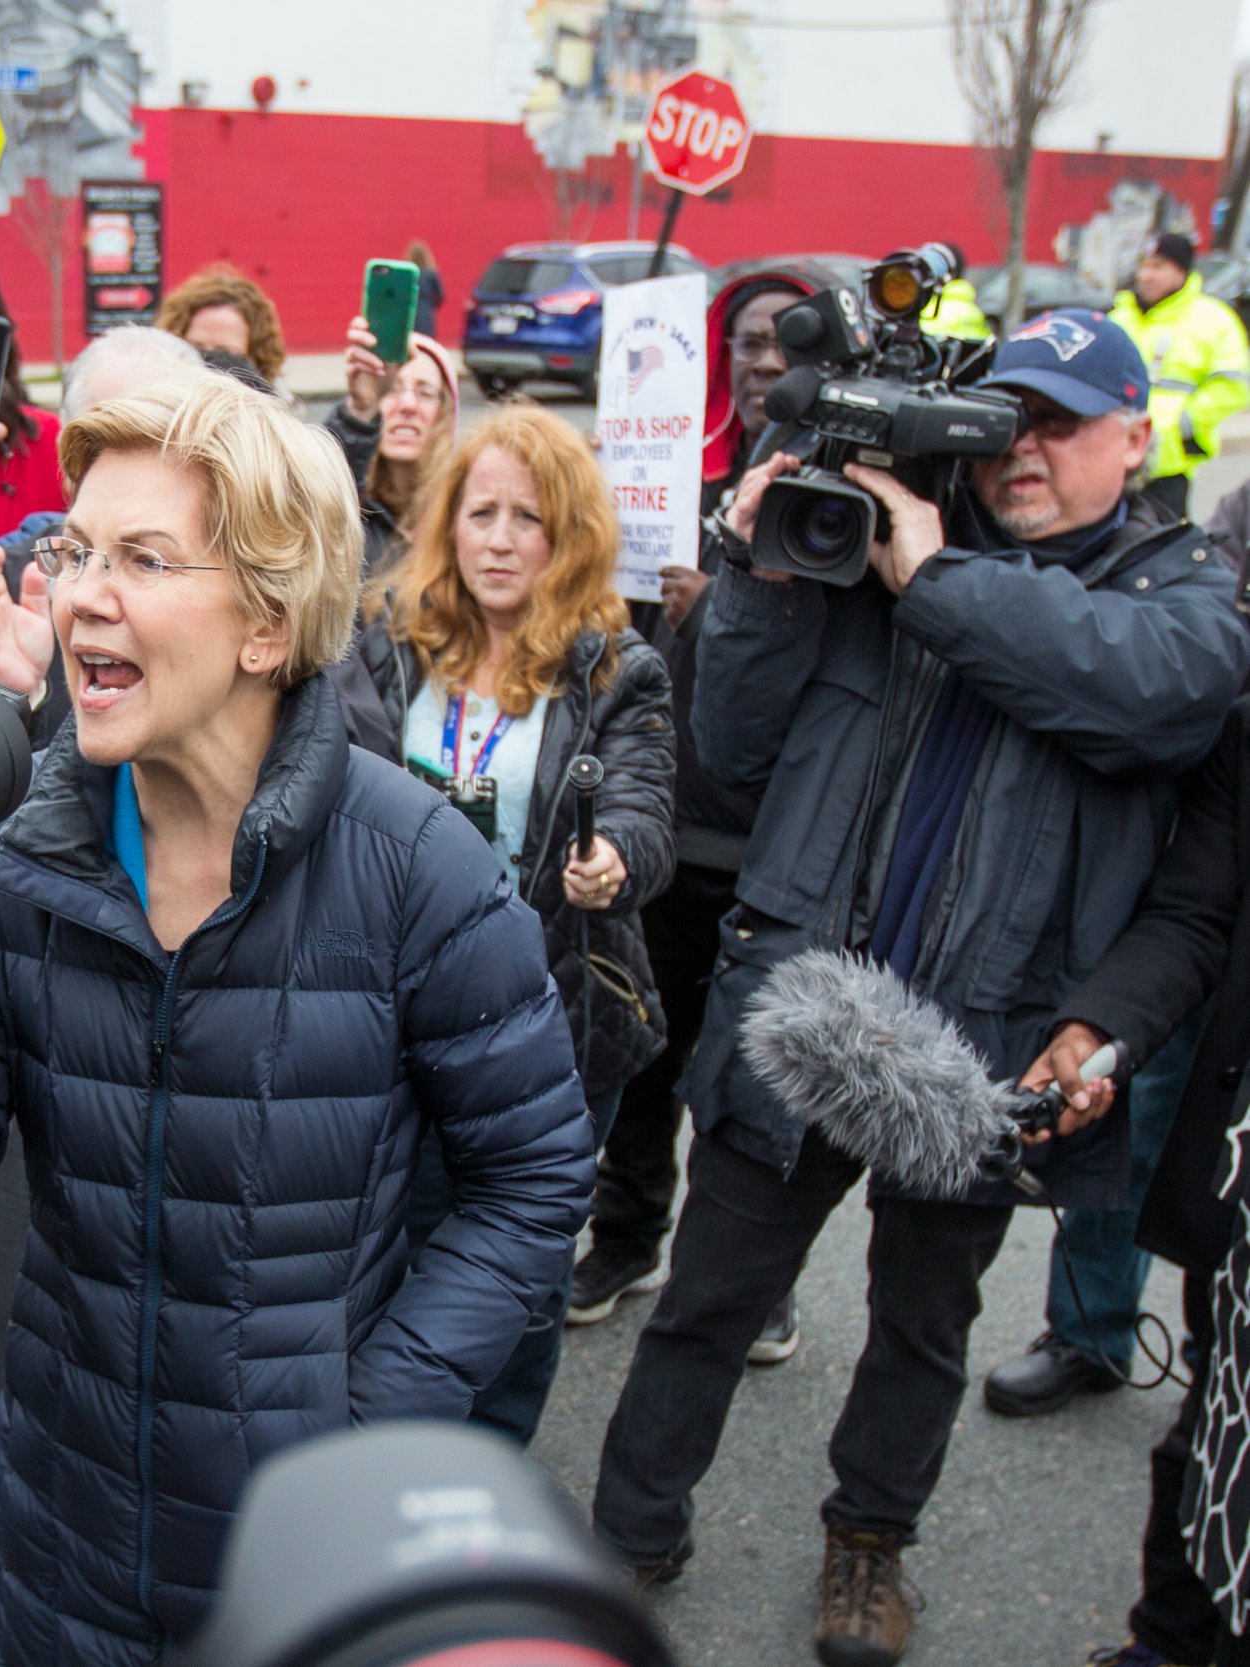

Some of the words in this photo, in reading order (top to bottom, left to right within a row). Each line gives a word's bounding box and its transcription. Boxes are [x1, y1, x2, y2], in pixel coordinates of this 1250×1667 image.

[650, 95, 743, 161] STOP
[636, 417, 648, 440] &
[651, 414, 692, 440] SHOP
[612, 443, 673, 462] EMPLOYEES
[632, 465, 648, 482] ON
[612, 485, 669, 512] STRIKE
[326, 928, 351, 940] THE
